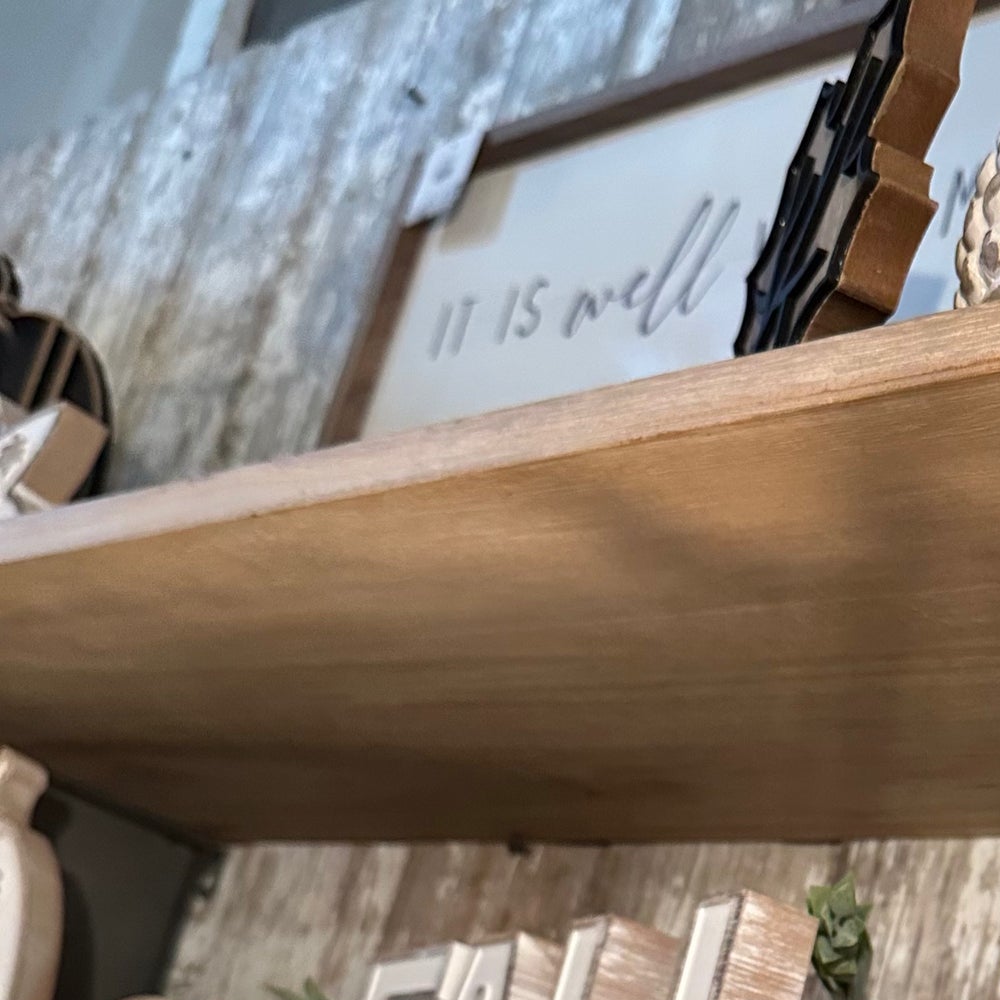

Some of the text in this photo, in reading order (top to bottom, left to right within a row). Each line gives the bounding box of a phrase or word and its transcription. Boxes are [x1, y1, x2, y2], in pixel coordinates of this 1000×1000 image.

[428, 295, 476, 361] IT
[494, 274, 549, 345] IS
[562, 194, 740, 338] well
